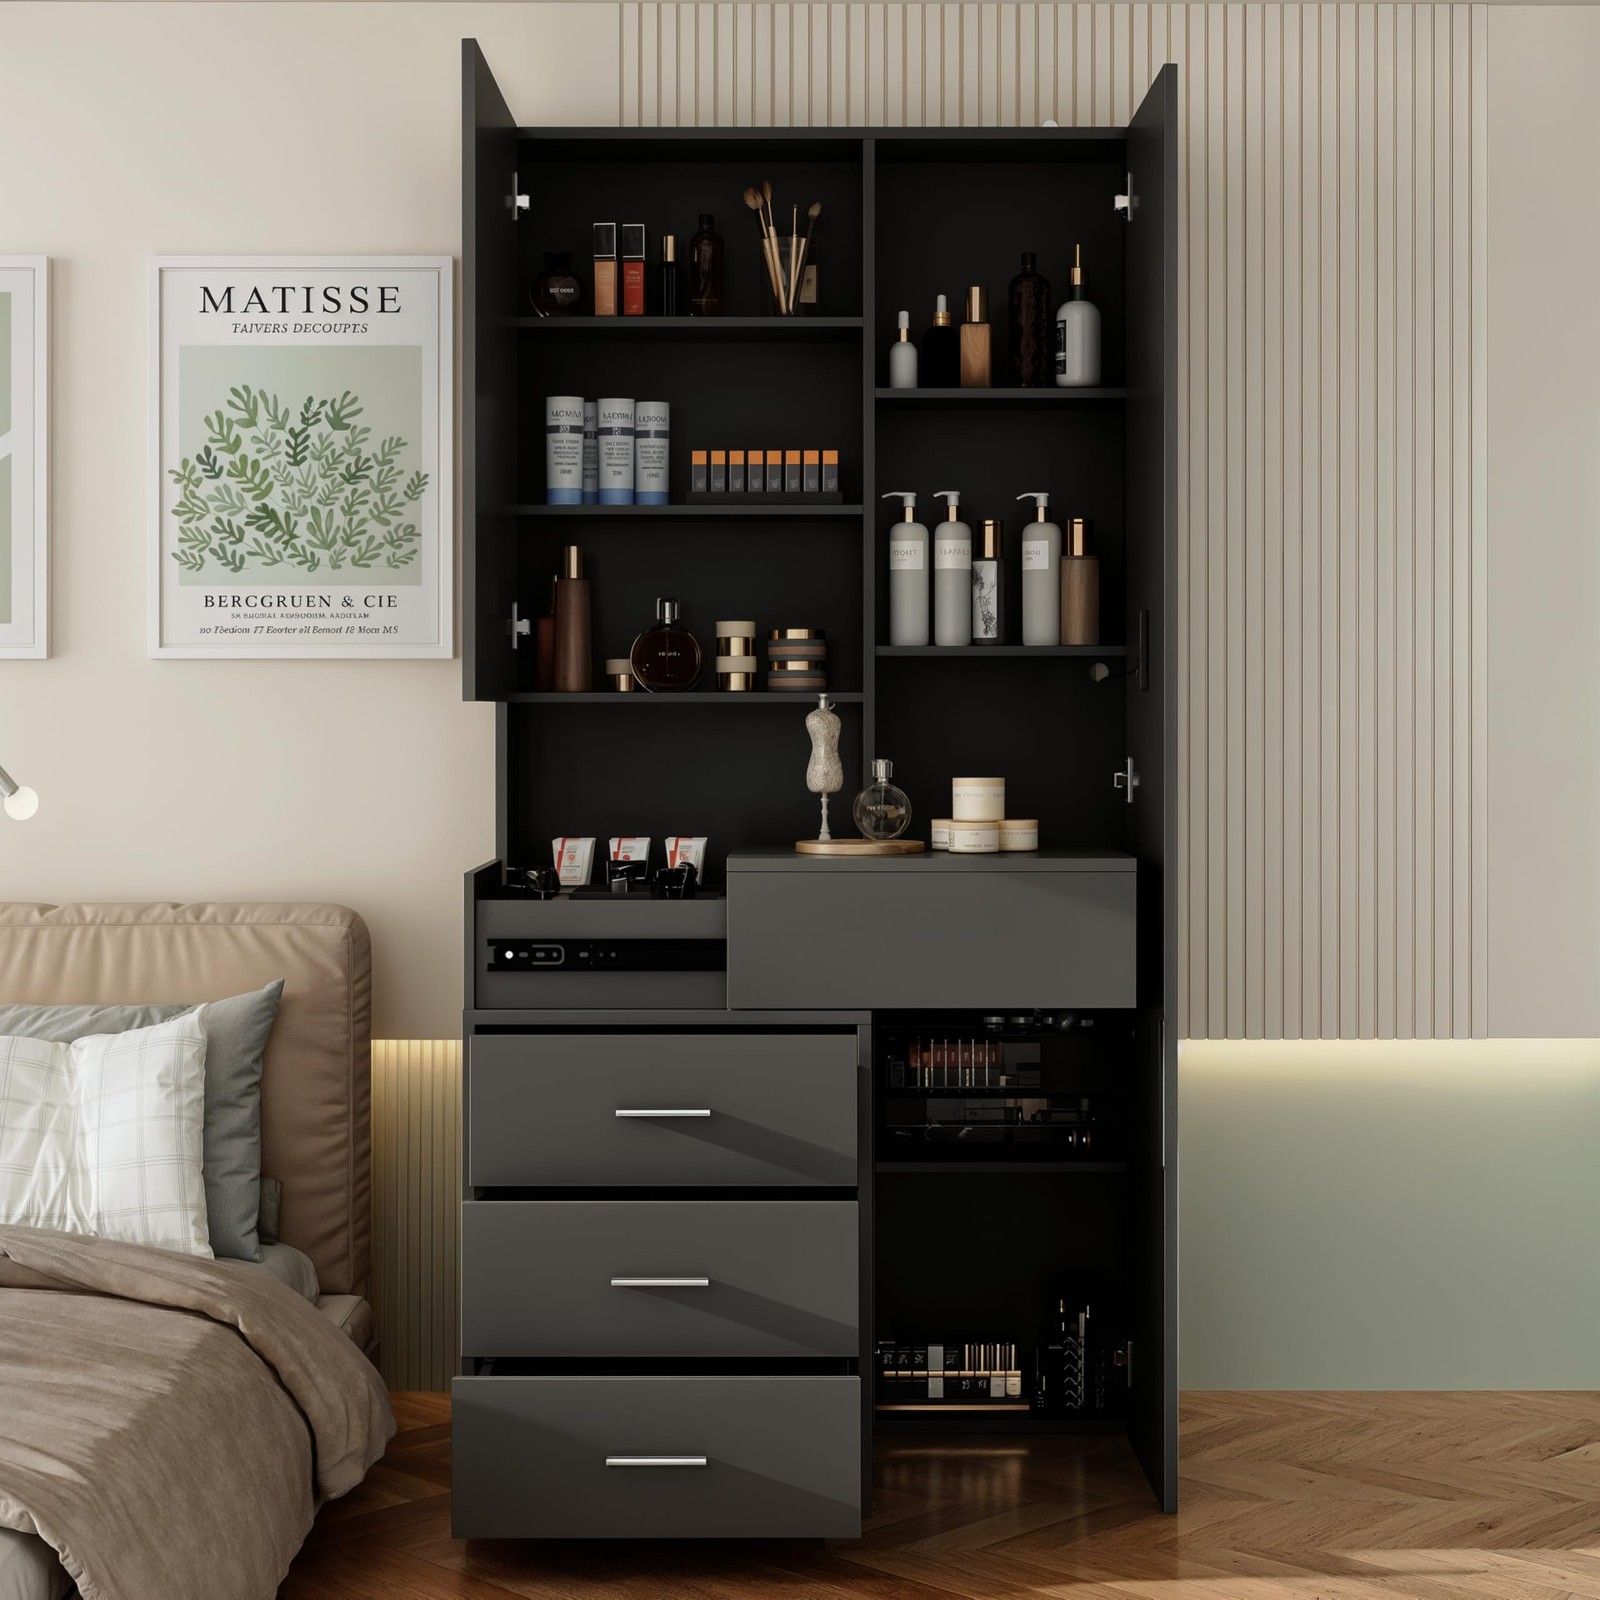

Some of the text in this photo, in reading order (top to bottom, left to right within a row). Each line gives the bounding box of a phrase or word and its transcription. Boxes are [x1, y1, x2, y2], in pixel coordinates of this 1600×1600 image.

[199, 286, 402, 314] MATISSE
[341, 595, 355, 608] &
[364, 595, 398, 608] CIE
